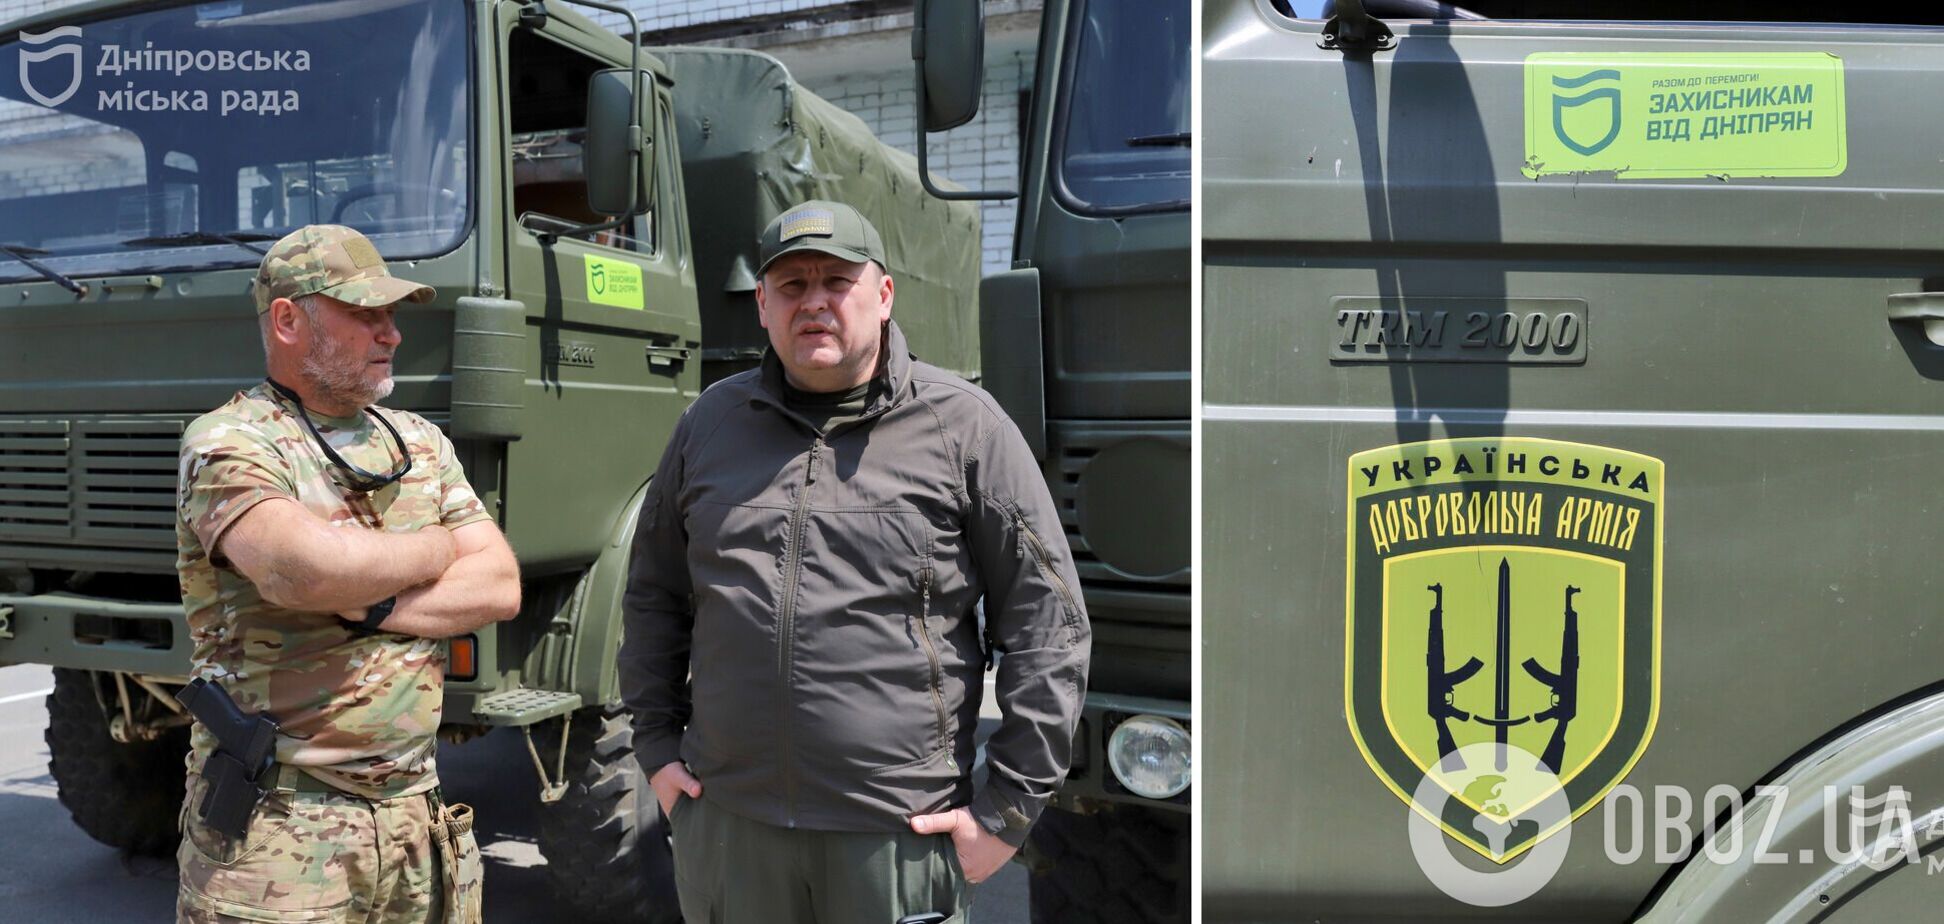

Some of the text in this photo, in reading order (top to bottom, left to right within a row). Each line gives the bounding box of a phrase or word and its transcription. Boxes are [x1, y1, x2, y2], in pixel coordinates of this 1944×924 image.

[1649, 84, 1813, 114] ЗАХИСНИКАМ
[1652, 74, 1759, 88] РАЗОМ ДО ПЕРЕМОГИ!
[1646, 111, 1813, 143] ВІД ДНІПРЯН
[1337, 310, 1580, 353] TRM 2000
[1361, 447, 1650, 493] УКРАЇНСЬКА
[1369, 491, 1641, 555] ДОБРОВОЛЬЧА АРМІЯ
